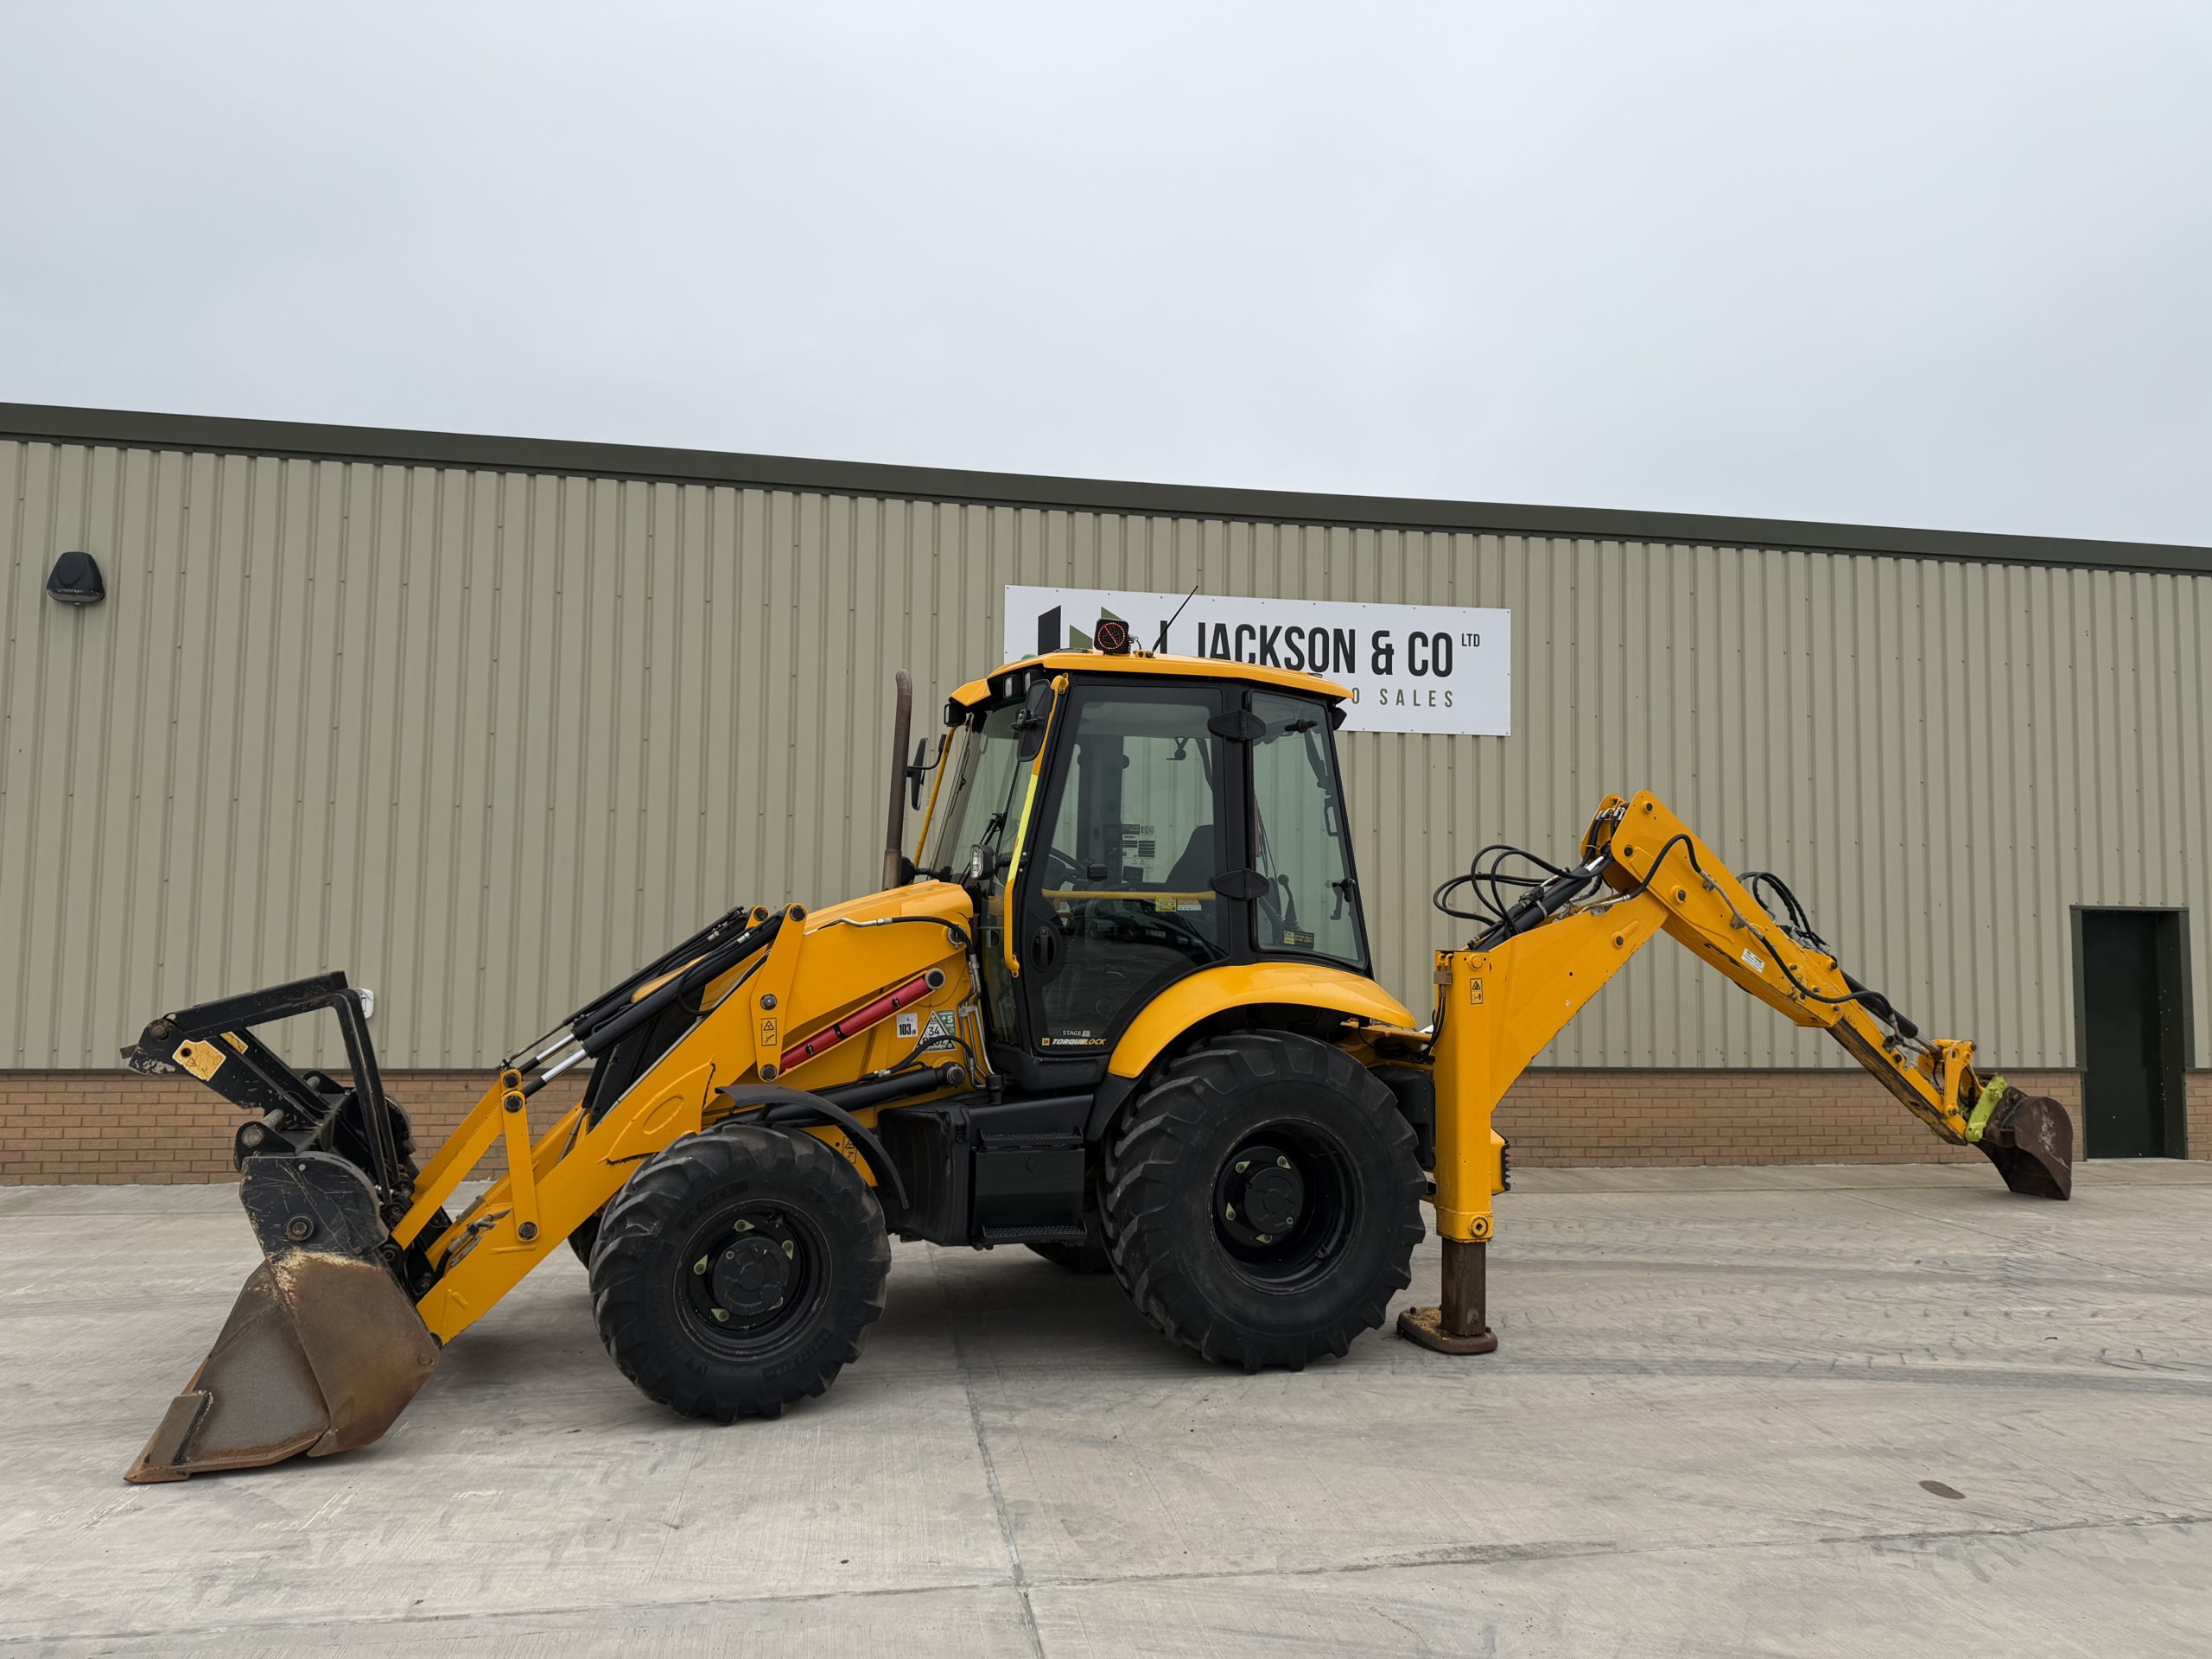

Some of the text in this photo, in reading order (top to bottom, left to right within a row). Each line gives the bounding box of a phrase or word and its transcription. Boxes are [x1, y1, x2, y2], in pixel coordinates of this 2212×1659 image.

[1198, 621, 1357, 674] JACKSON
[1370, 630, 1395, 677] &
[1408, 631, 1453, 678] CO
[1461, 632, 1480, 647] LTD
[1379, 688, 1453, 708] SALES
[899, 1023, 912, 1035] 103
[928, 1027, 939, 1036] 34
